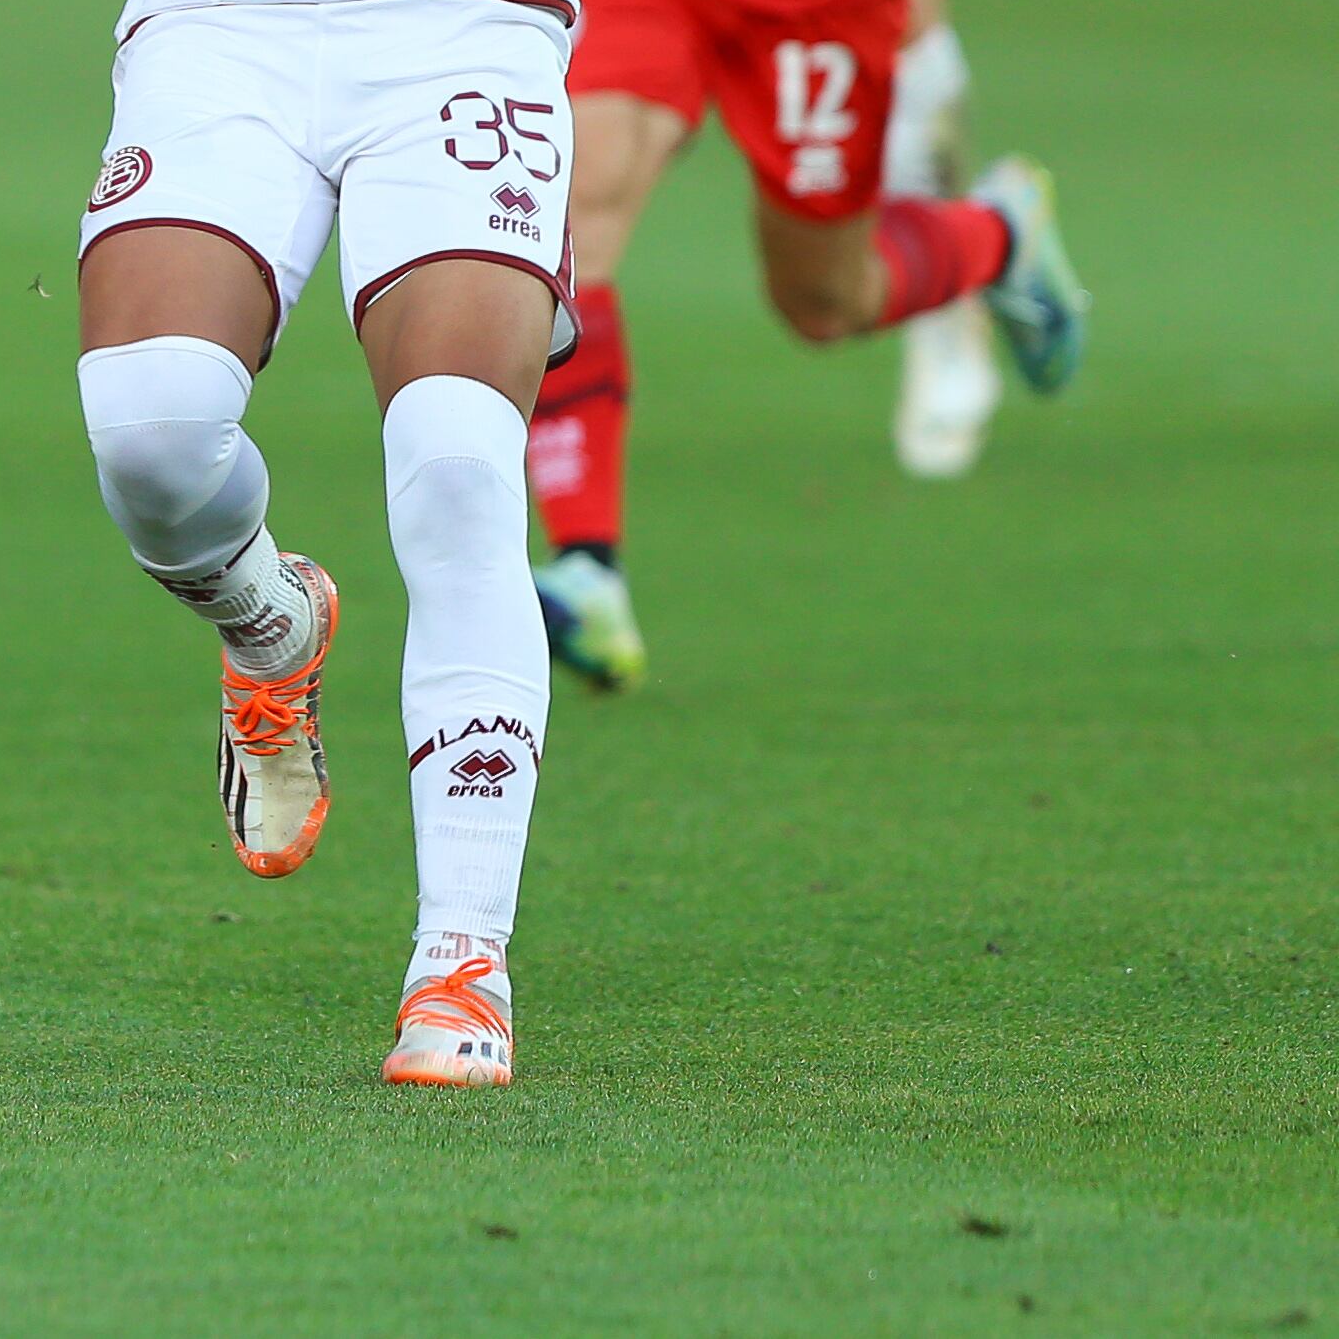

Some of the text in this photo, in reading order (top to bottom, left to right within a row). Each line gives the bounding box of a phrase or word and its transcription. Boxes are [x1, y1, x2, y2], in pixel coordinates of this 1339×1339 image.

[774, 38, 858, 142] 12
[440, 91, 561, 183] 35
[488, 213, 541, 243] errea
[447, 783, 503, 798] errea
